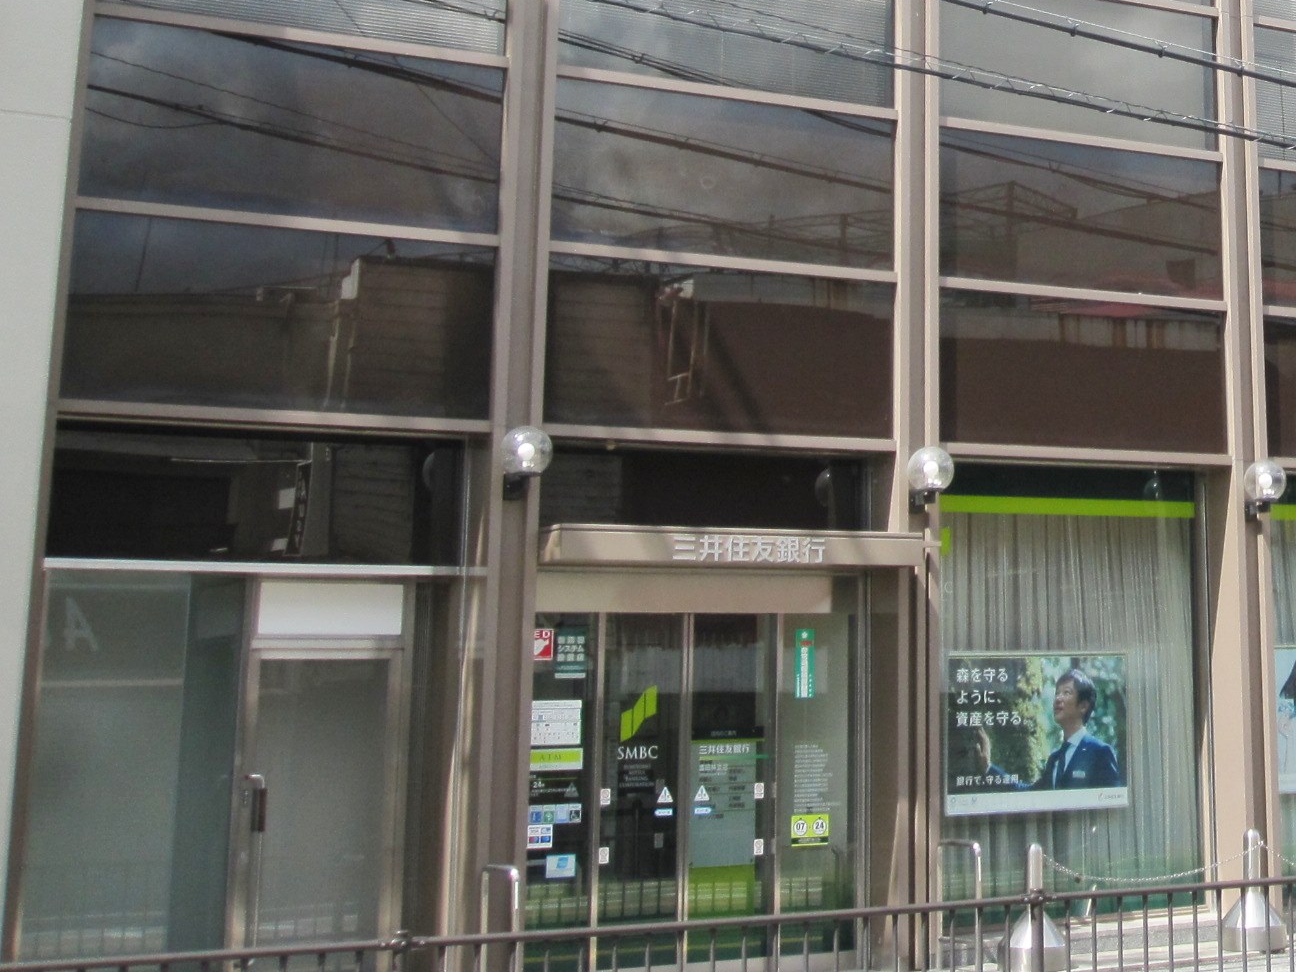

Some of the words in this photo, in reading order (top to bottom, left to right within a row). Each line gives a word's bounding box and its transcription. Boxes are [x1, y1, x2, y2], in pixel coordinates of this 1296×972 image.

[672, 534, 826, 563] 三井住友銀行
[956, 667, 1009, 683] 森を守る
[956, 689, 1003, 705] ように、
[956, 710, 1028, 728] 資産を守る。
[617, 745, 659, 760] SMBC
[699, 744, 751, 755] 三井住友銀行
